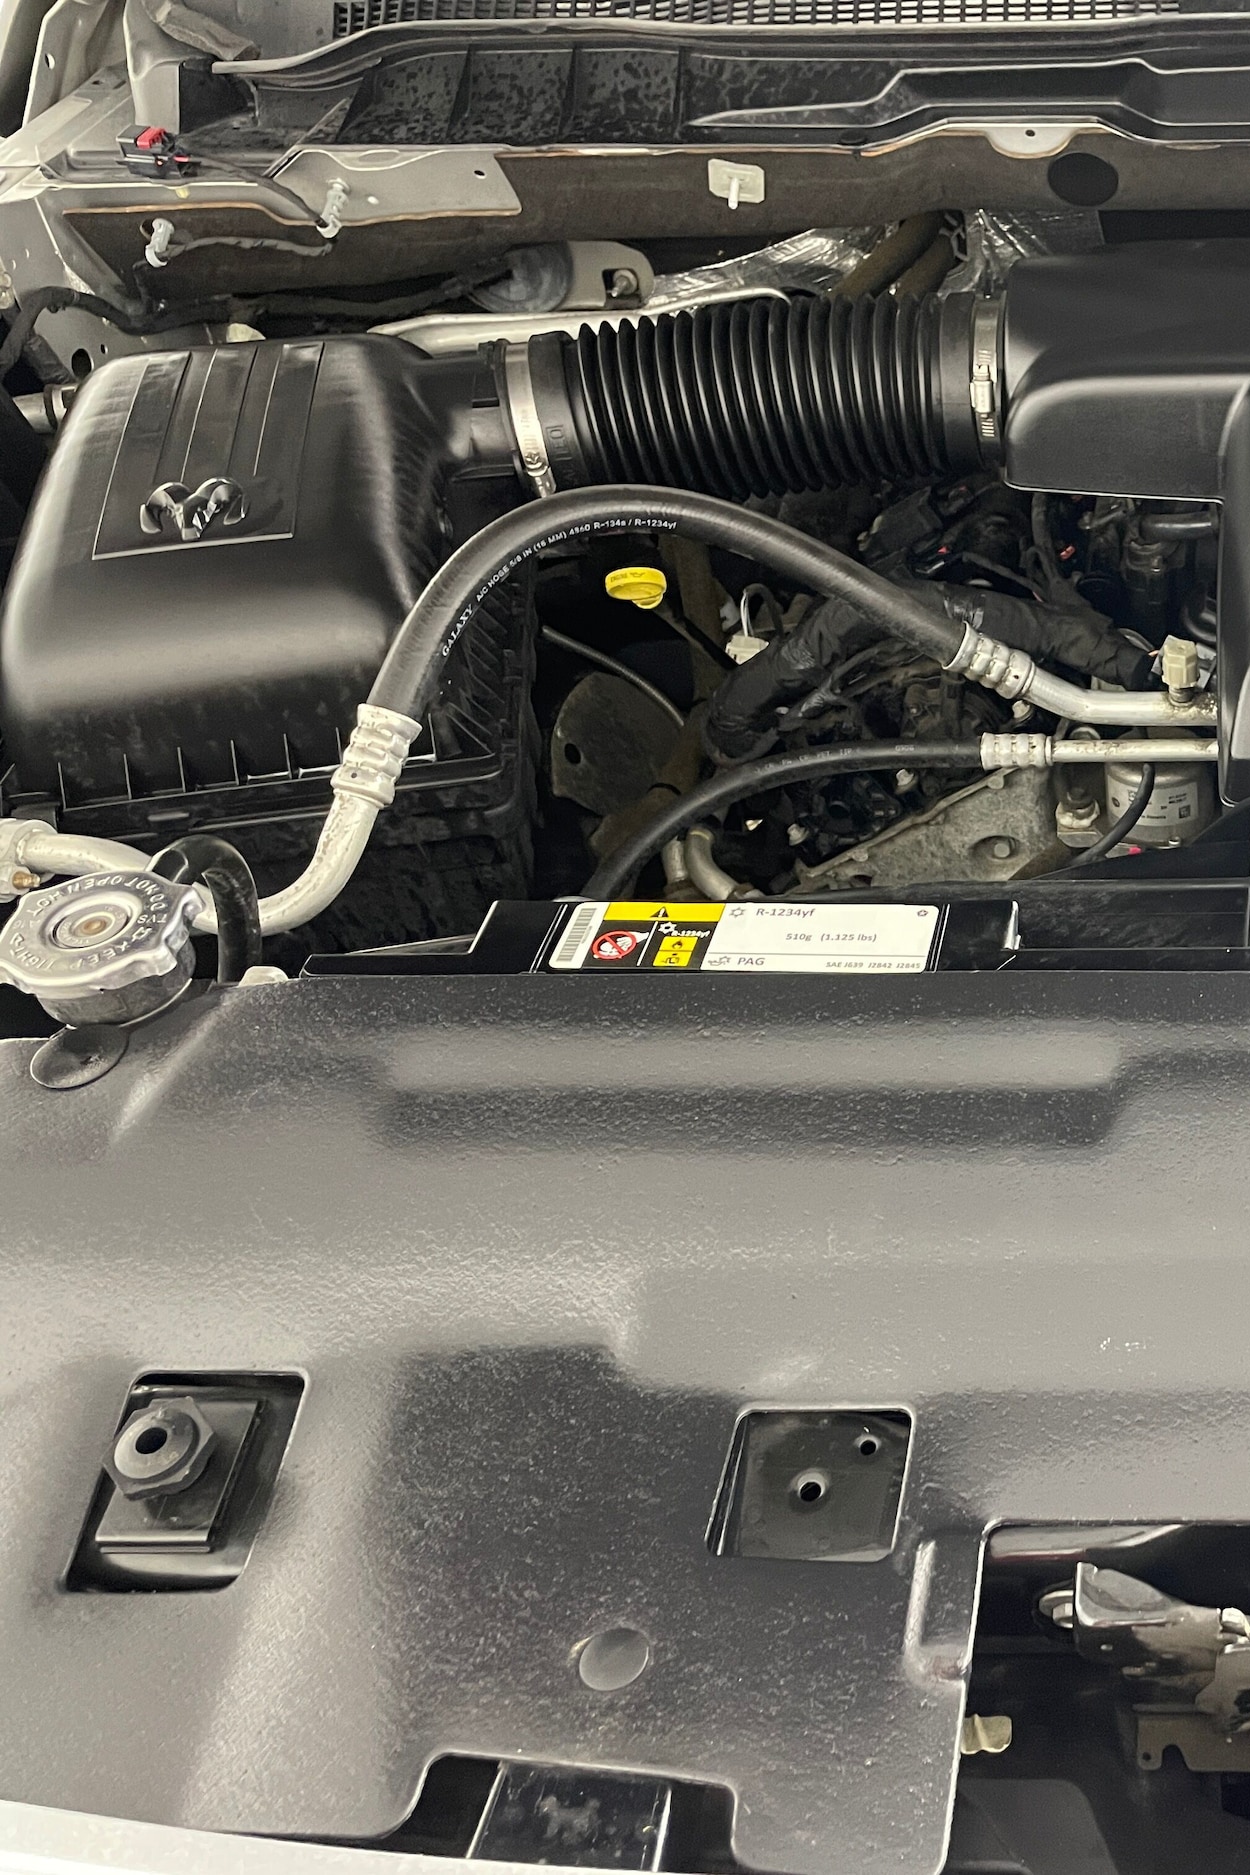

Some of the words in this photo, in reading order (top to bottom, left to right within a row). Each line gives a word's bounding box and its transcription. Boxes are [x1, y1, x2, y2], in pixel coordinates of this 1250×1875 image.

[442, 603, 473, 657] GALAXY
[476, 586, 489, 602] A/C
[522, 547, 533, 558] IN
[547, 531, 567, 544] MM)
[593, 518, 626, 529] R-134a
[634, 518, 677, 530] R-1234yf
[66, 875, 123, 895] OPEN
[124, 877, 161, 896] NOT
[26, 891, 63, 918] HOT
[136, 914, 168, 925] TVS
[756, 908, 816, 919] R-1234yf
[785, 933, 813, 942] 510g
[820, 933, 855, 943] (1.125
[857, 933, 877, 943] lbs)
[69, 940, 129, 970] KEEP
[737, 957, 766, 966] PAG
[843, 961, 864, 969] J639
